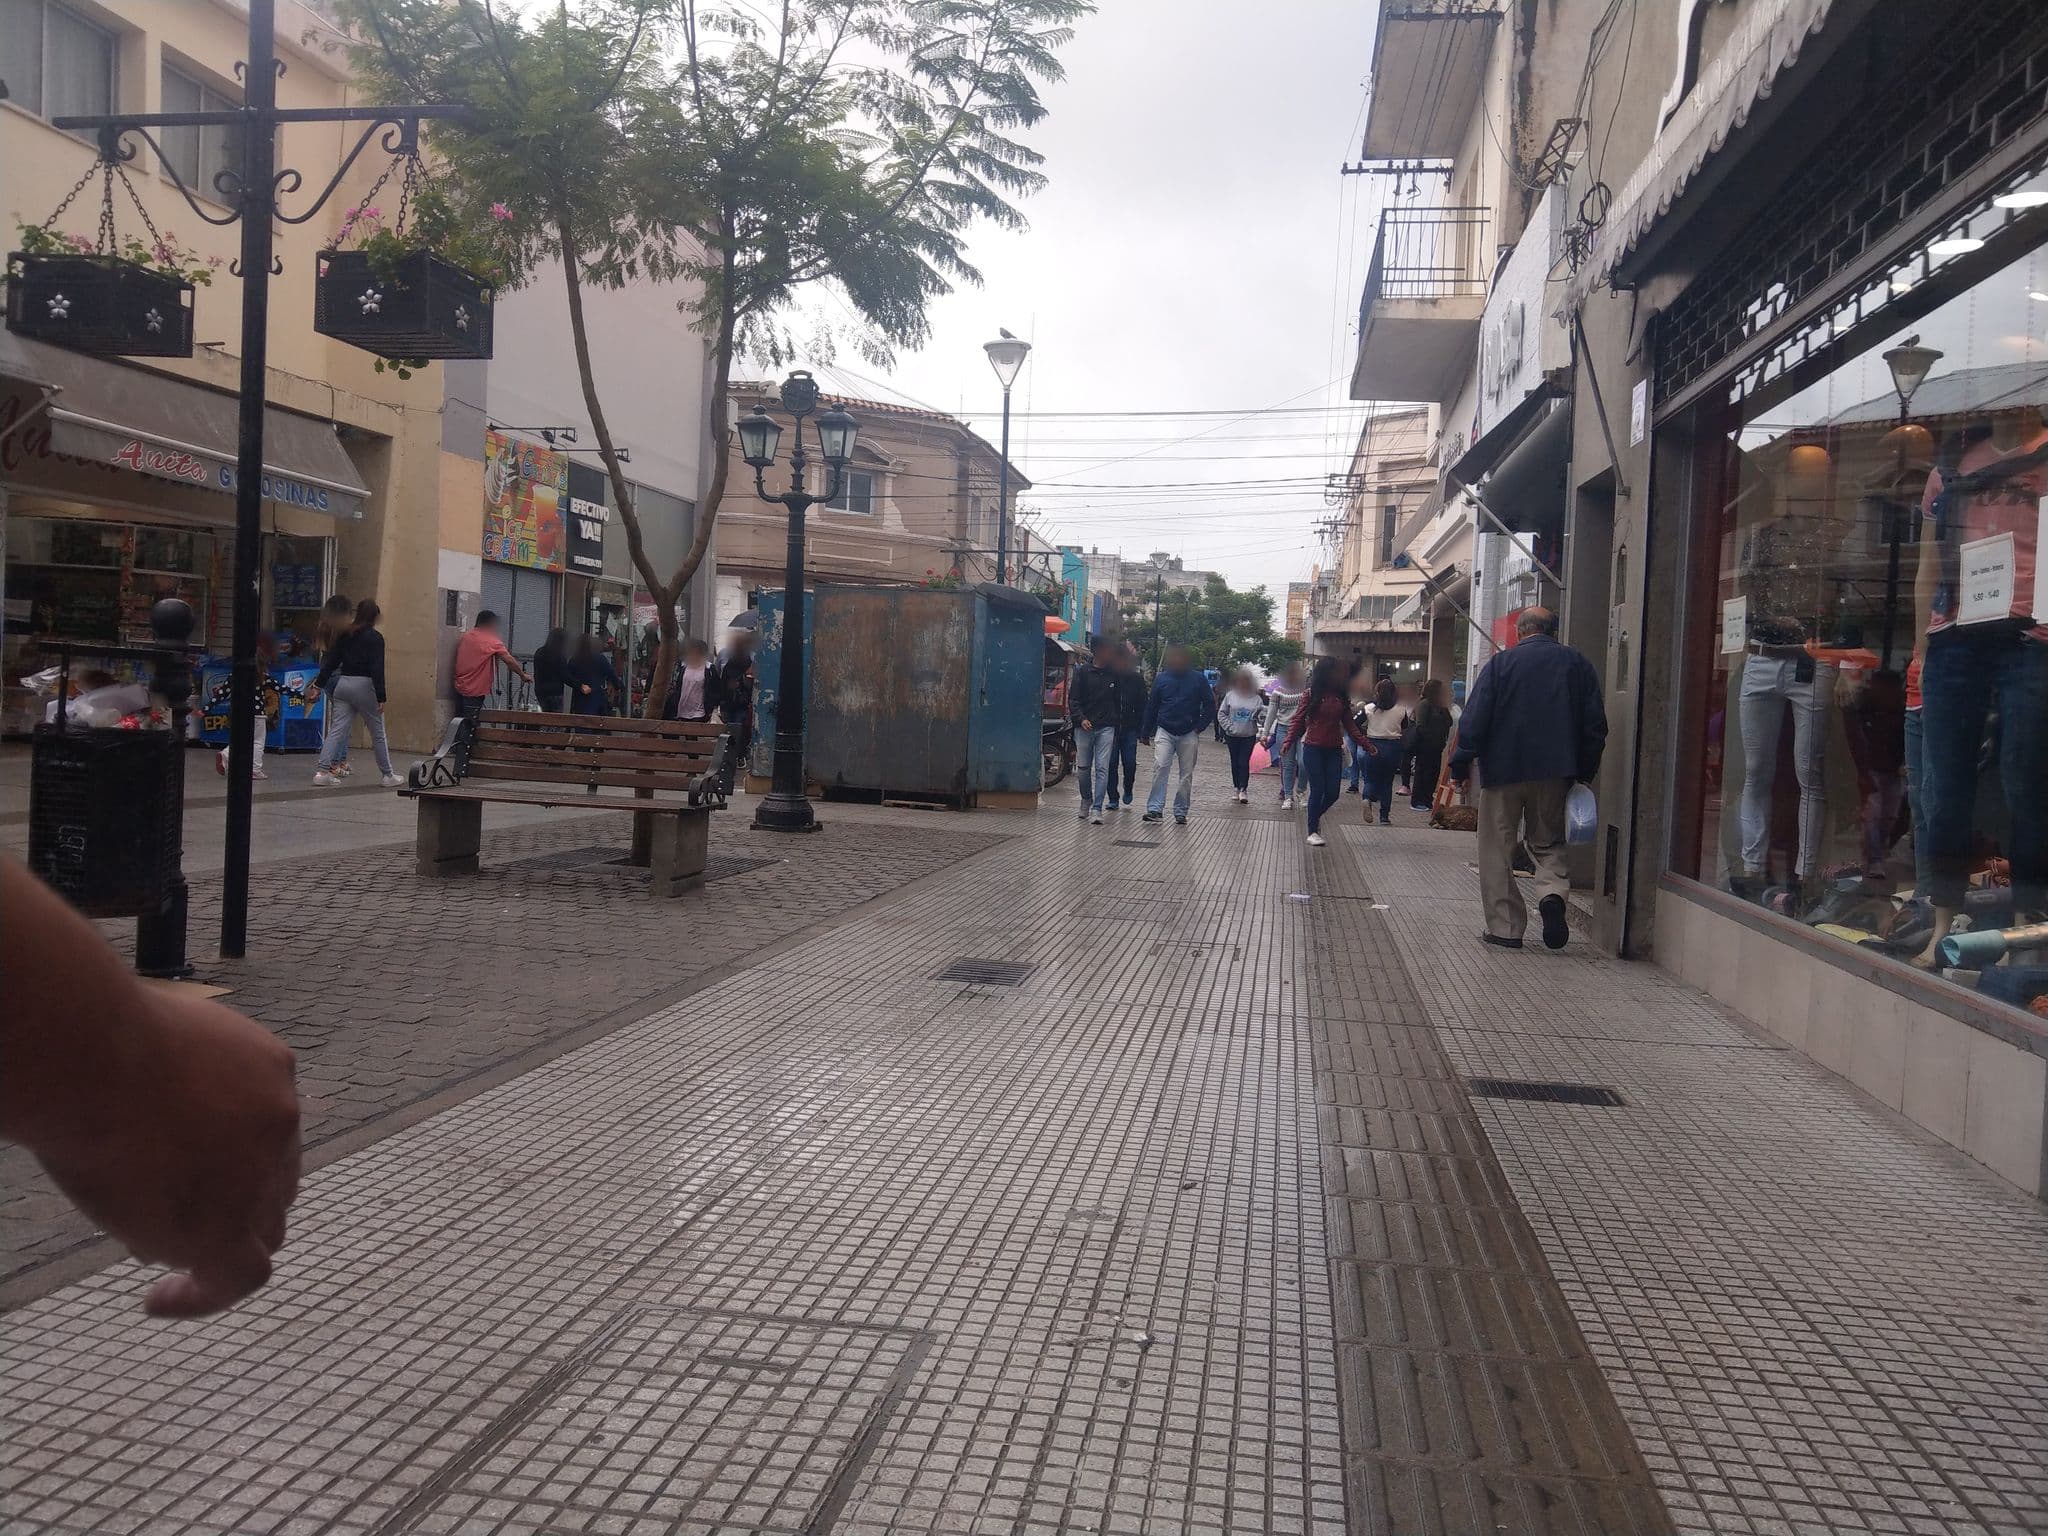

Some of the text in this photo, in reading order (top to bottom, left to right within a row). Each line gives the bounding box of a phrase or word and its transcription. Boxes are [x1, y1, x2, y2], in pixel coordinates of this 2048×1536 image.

[111, 440, 329, 511] Anita GOSINAS
[570, 497, 609, 521] EFECTIVO
[483, 533, 529, 562] CREAM
